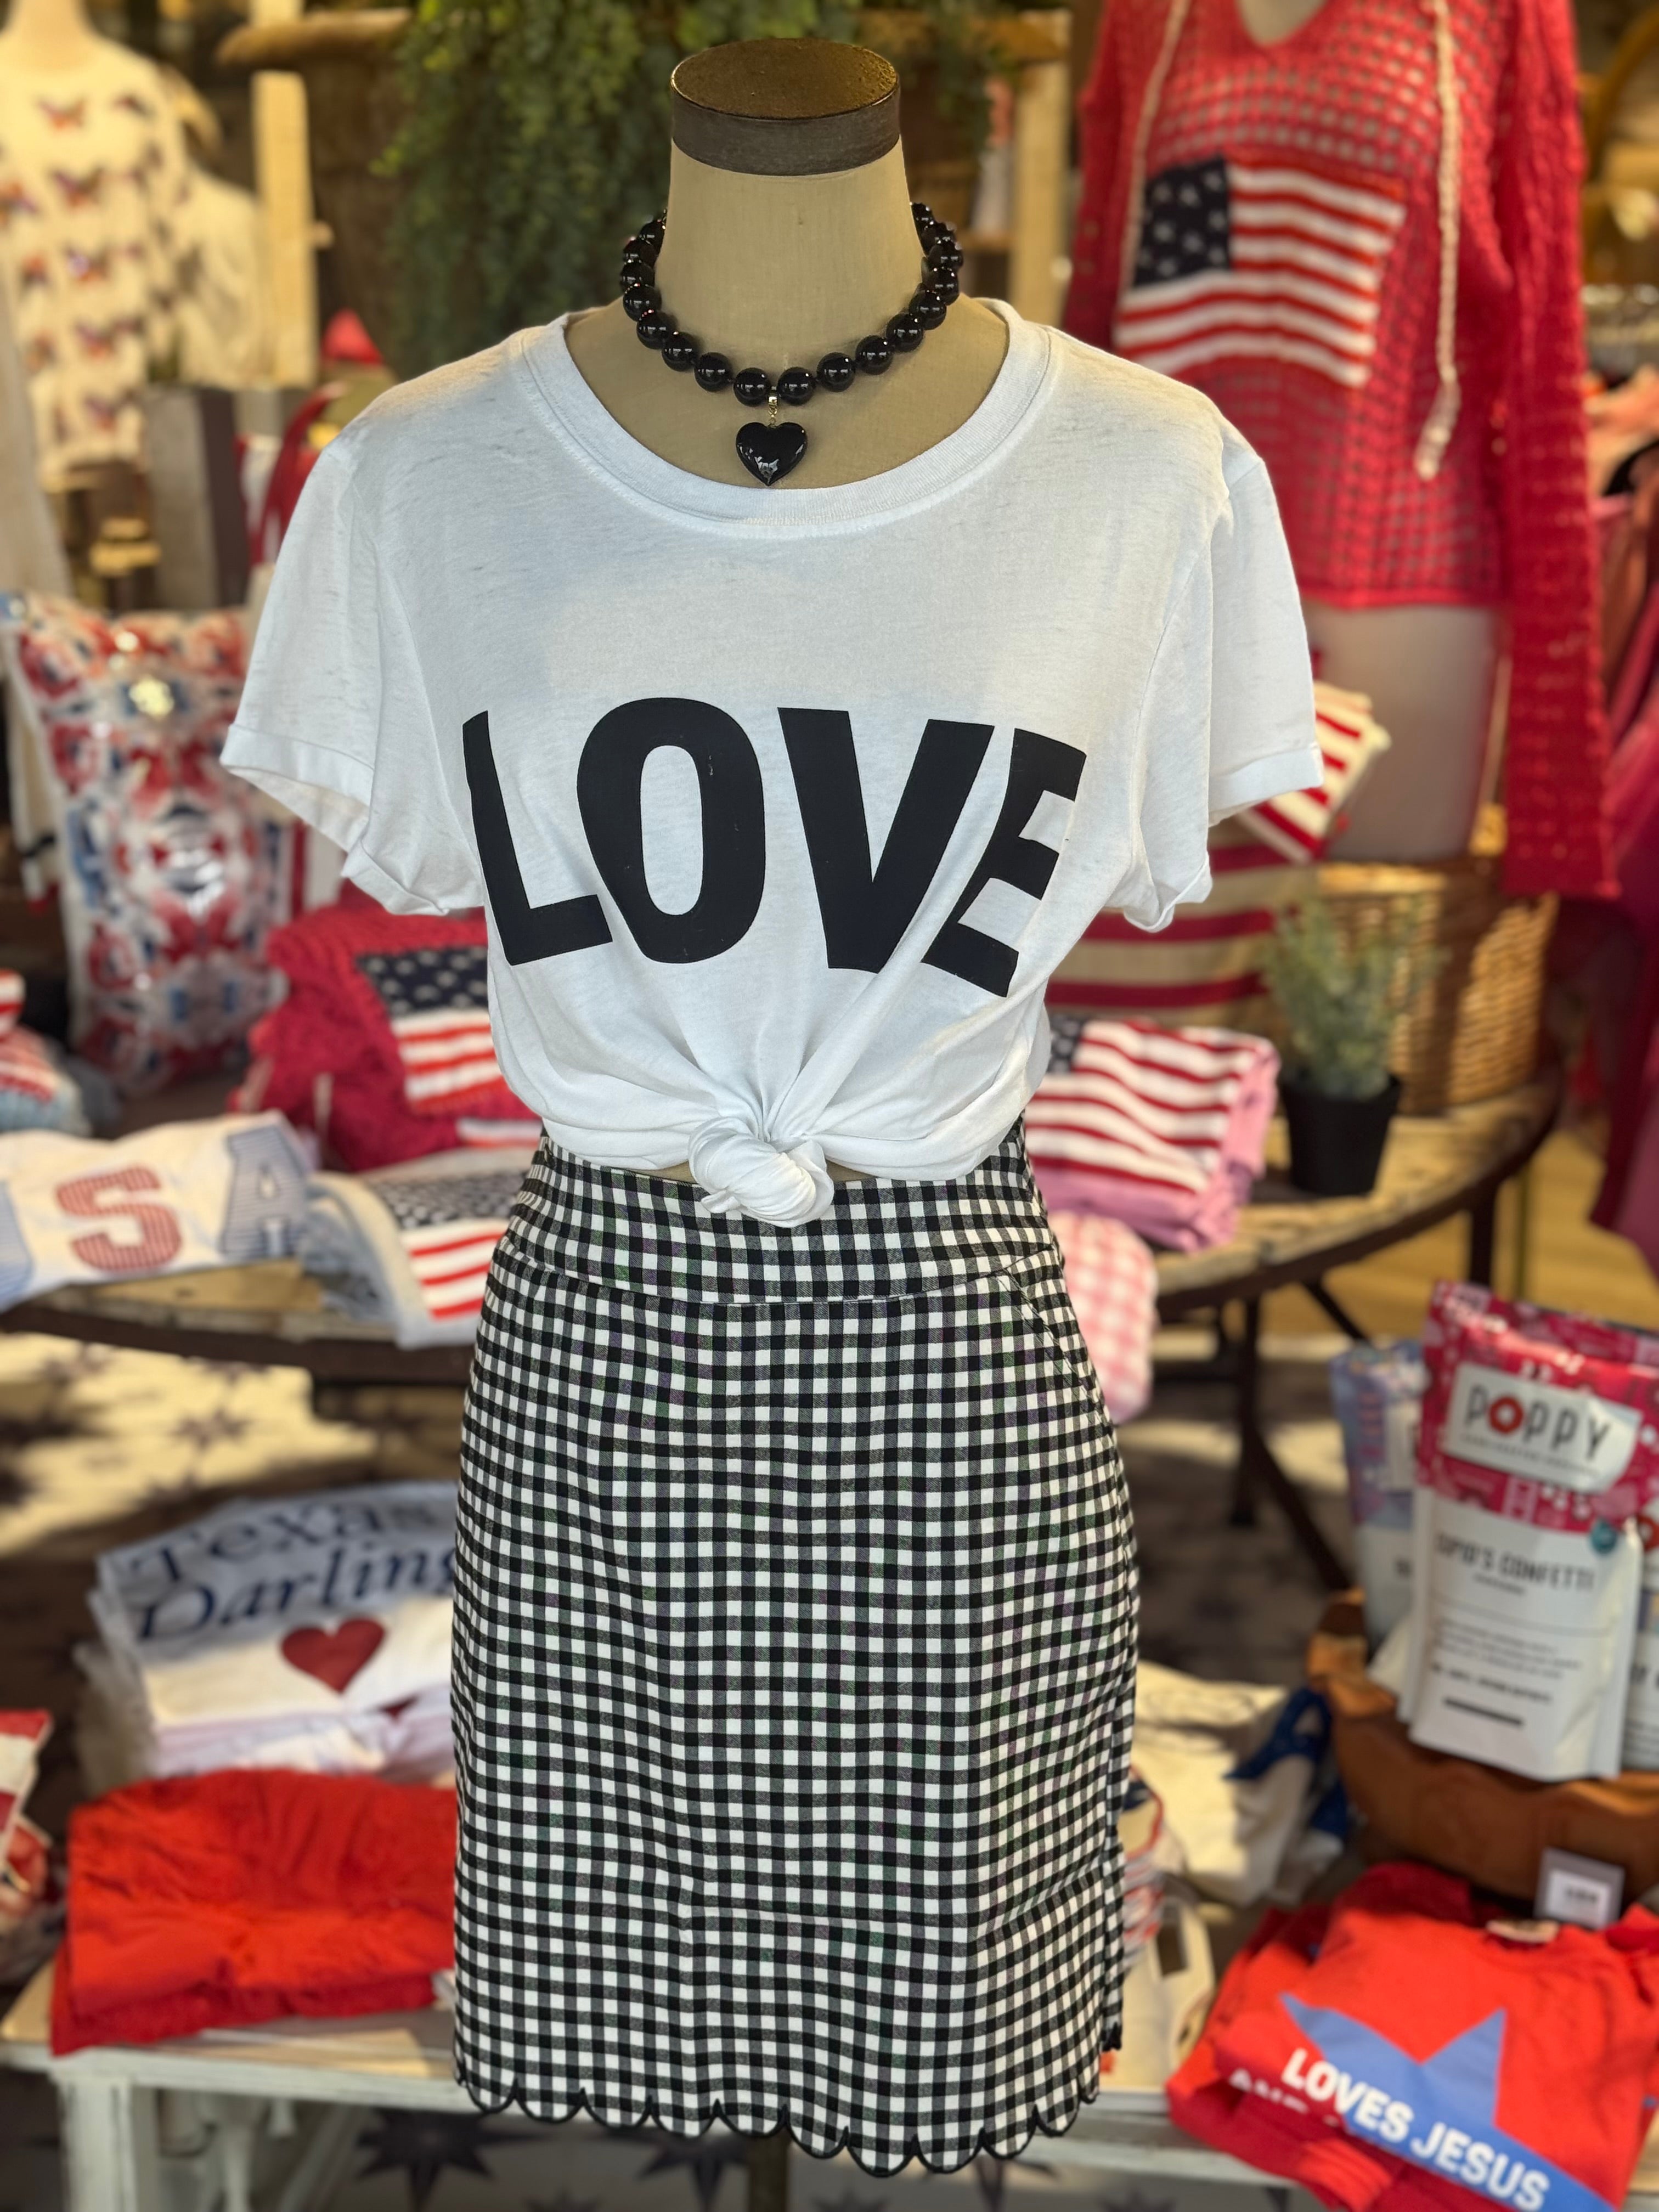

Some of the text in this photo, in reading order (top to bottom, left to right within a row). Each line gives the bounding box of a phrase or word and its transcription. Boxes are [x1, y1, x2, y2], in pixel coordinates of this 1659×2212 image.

[462, 697, 1087, 997] LOVE
[1463, 1383, 1612, 1462] POPPY
[1281, 2047, 1414, 2142] LOVES
[1410, 2121, 1550, 2211] JESUS
